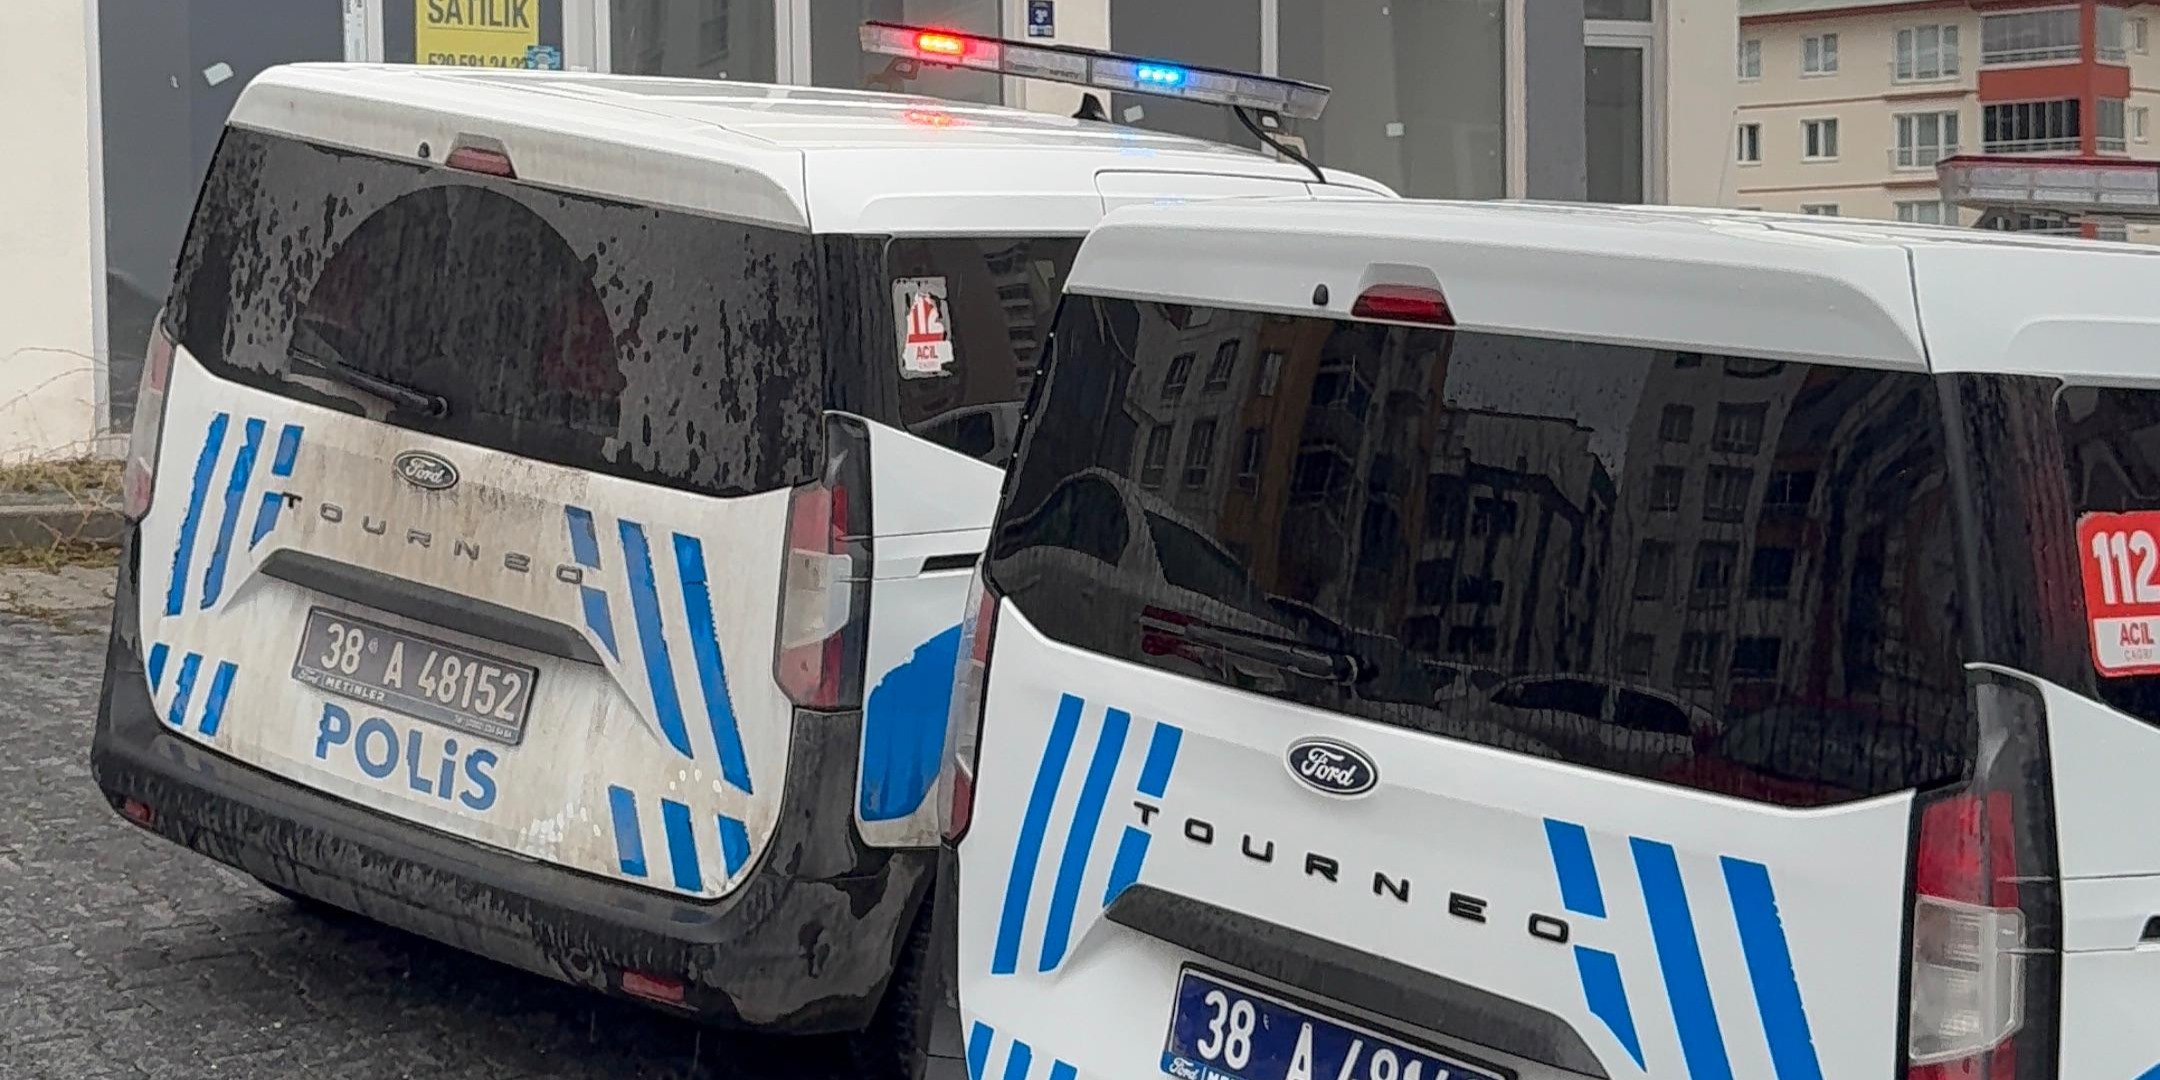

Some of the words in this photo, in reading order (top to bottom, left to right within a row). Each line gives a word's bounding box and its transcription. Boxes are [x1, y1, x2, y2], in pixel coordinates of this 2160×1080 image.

[282, 491, 583, 585] TOURNEO
[2092, 530, 2160, 604] 112
[321, 623, 365, 674] 38
[383, 641, 405, 688] A
[418, 650, 522, 722] 48152
[1300, 747, 1358, 787] Ford
[1133, 801, 1569, 944] TOURNEO
[1197, 990, 1256, 1070] 38
[1285, 1022, 1313, 1080] A
